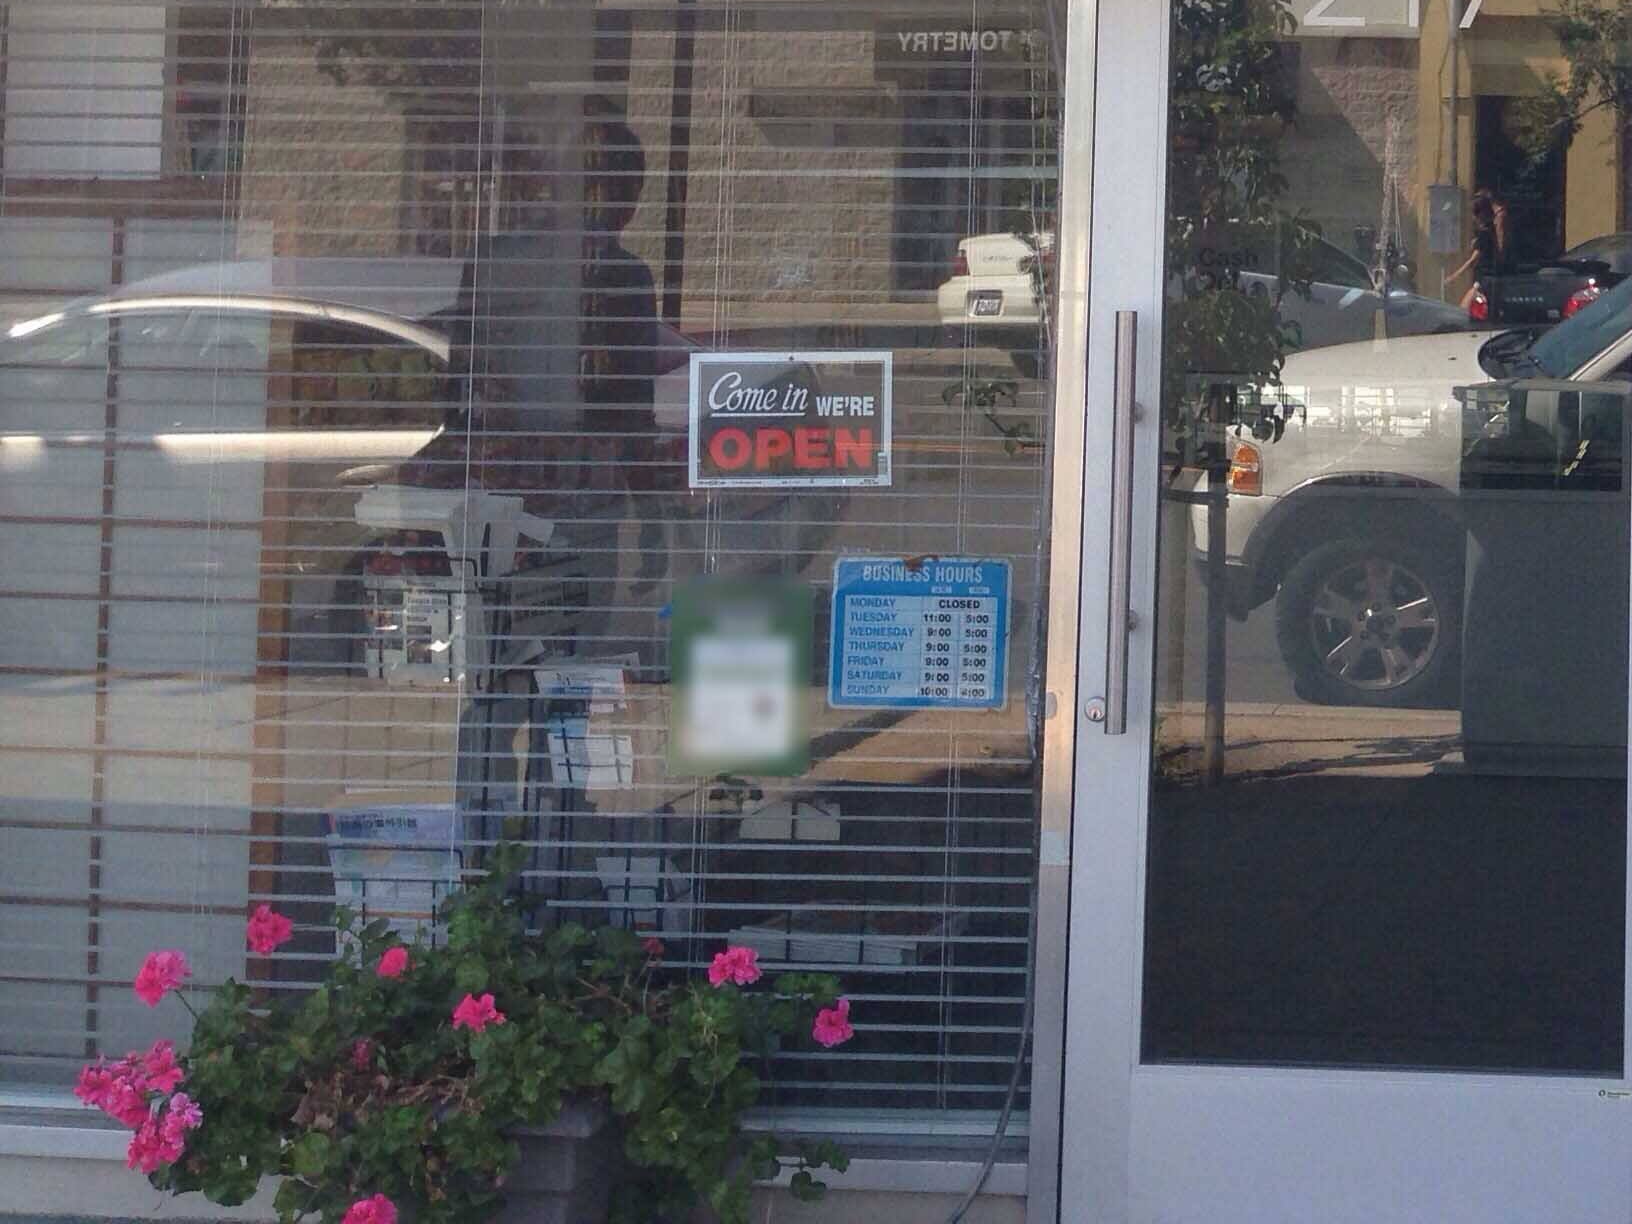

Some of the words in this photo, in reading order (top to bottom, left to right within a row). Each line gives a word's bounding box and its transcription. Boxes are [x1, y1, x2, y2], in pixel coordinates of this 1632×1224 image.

[708, 371, 778, 412] Come
[783, 383, 808, 411] in
[816, 395, 875, 417] WE'RE
[708, 427, 874, 470] OPEN
[863, 565, 930, 583] BUSINESS
[935, 566, 983, 583] HOURS
[849, 598, 896, 608] MONDAY
[938, 599, 981, 609] CLOSED
[849, 613, 898, 623] TUESDAY
[924, 614, 952, 623] 11:00
[966, 615, 989, 624] 5:00
[849, 627, 914, 637] WEDNESDAY
[848, 642, 905, 652] THURSDAY
[925, 642, 950, 653] 9:00
[847, 656, 884, 666] FRIDAY
[847, 670, 903, 681] SATURDAY
[924, 672, 950, 682] 9:00
[961, 672, 985, 682] 5:00
